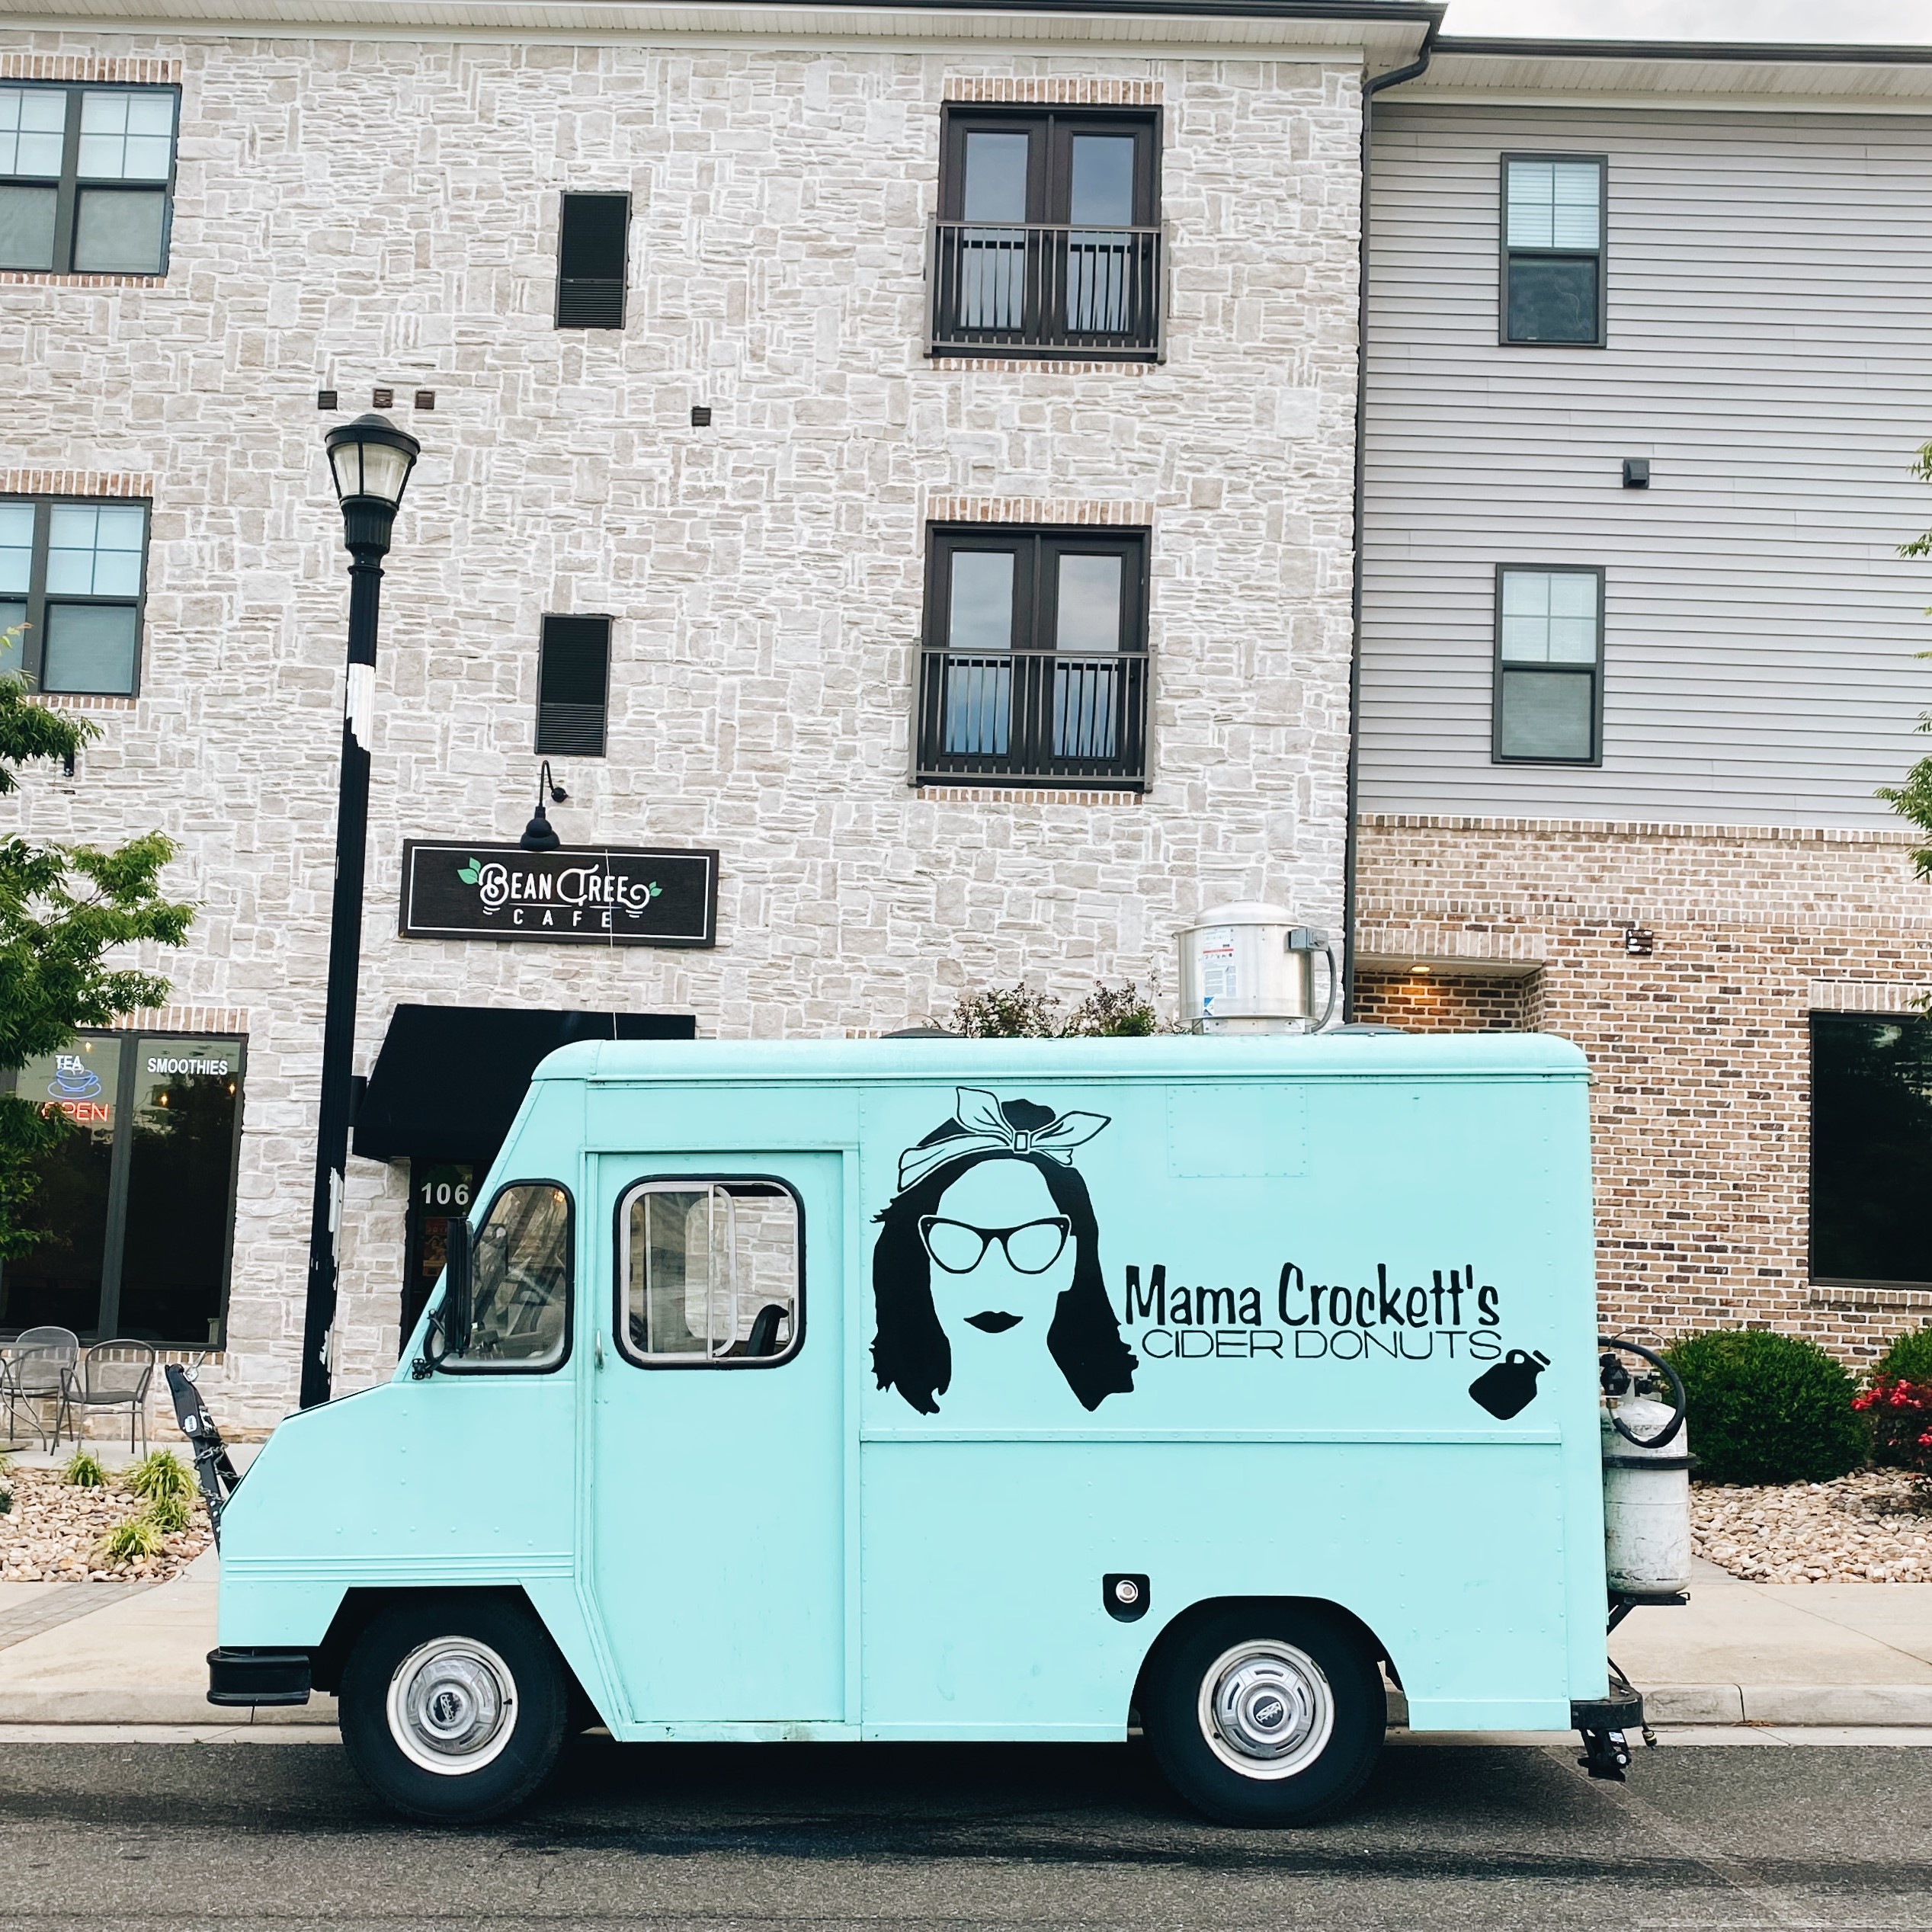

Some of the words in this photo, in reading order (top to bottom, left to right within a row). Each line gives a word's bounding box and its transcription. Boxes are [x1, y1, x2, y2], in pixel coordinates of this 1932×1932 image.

[478, 862, 552, 907] BEAN
[556, 863, 650, 909] TREE
[513, 909, 611, 928] CAFE
[55, 1055, 83, 1071] TEA
[147, 1057, 228, 1075] SMOOTHIES
[421, 1183, 469, 1205] 106
[1125, 1264, 1261, 1327] Mama
[1278, 1262, 1500, 1328] Crockett's
[1142, 1328, 1283, 1360] CIDER
[1295, 1329, 1503, 1361] DONUTS
